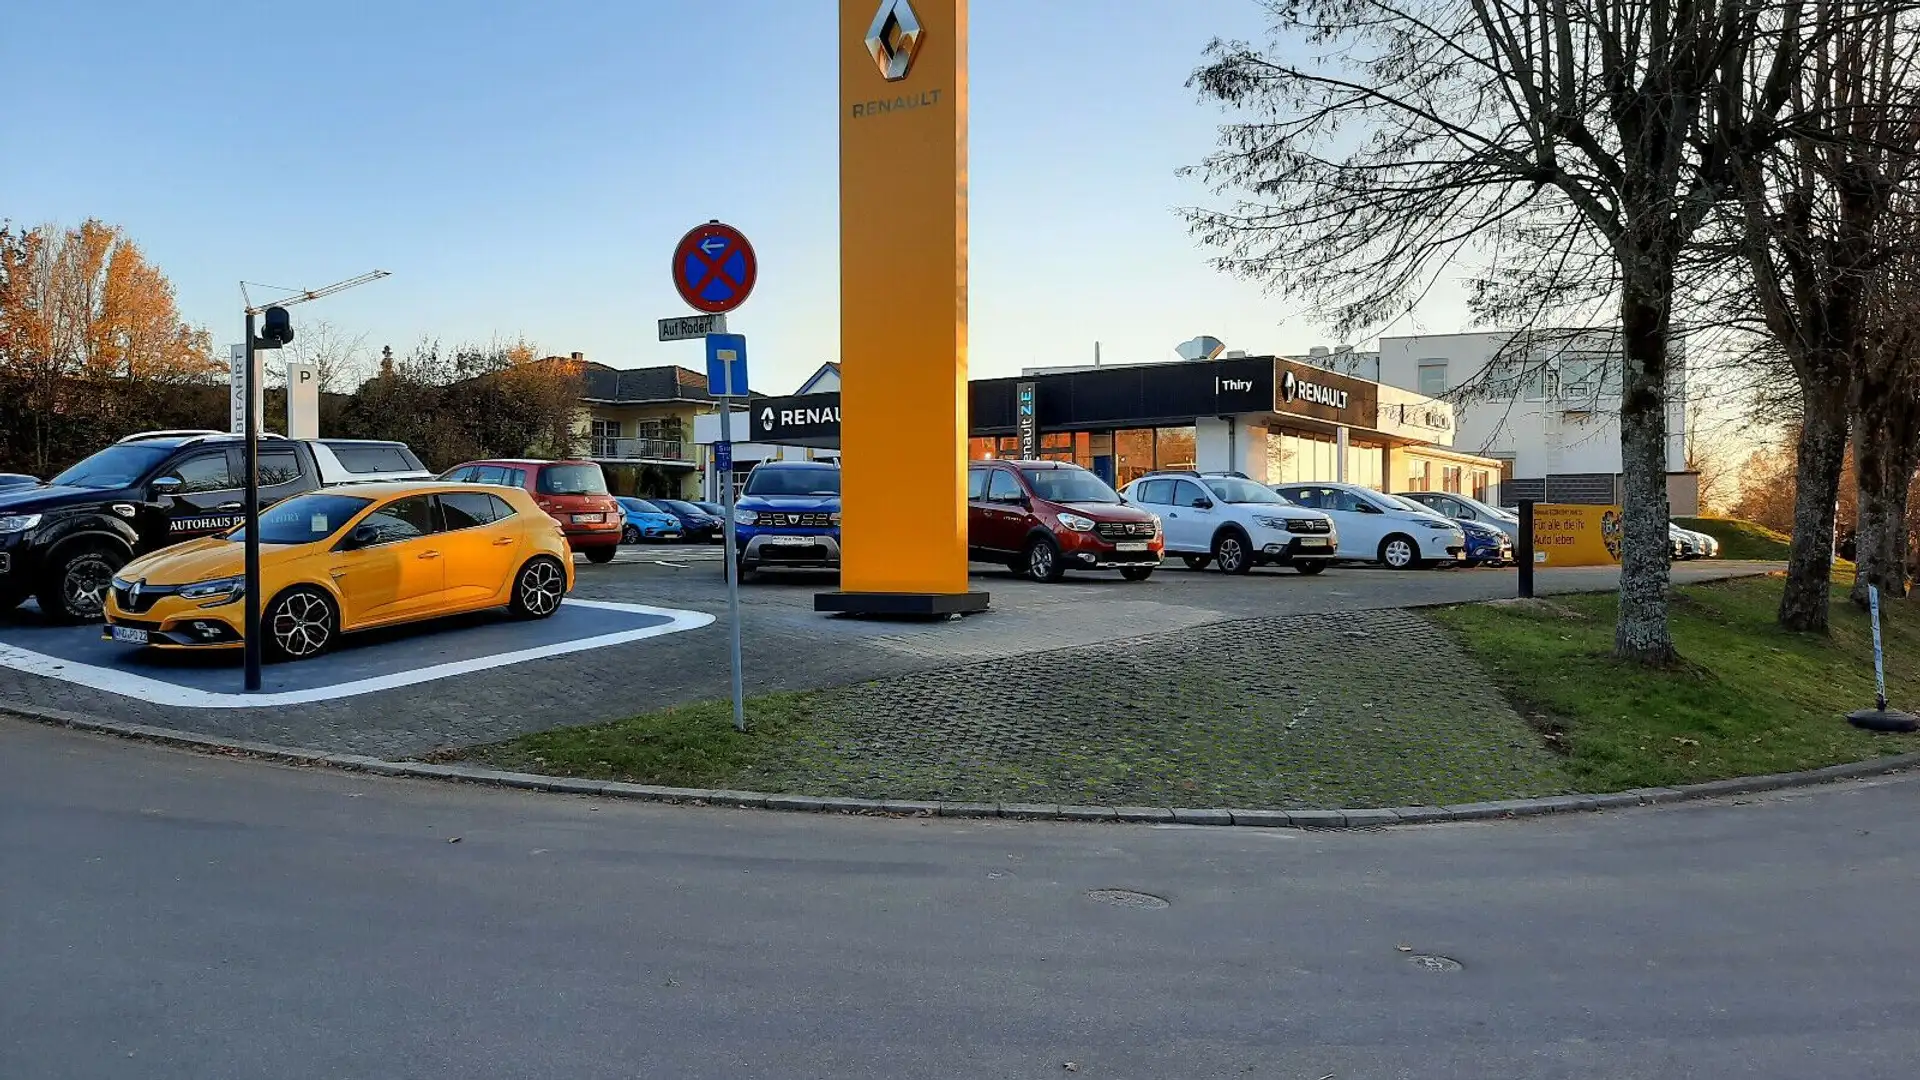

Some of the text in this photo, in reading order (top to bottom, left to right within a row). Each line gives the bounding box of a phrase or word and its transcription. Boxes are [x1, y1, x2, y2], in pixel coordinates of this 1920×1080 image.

[852, 89, 942, 118] RENAULT
[663, 322, 678, 336] Auf
[300, 370, 311, 384] P
[235, 351, 244, 433] BEFAHRT
[1222, 379, 1253, 393] Thiry
[1298, 380, 1348, 410] RENAULT
[781, 406, 841, 426] RENAU
[1020, 418, 1032, 461] enault
[170, 517, 231, 531] AUTOHAUS
[1534, 534, 1552, 545] Auto
